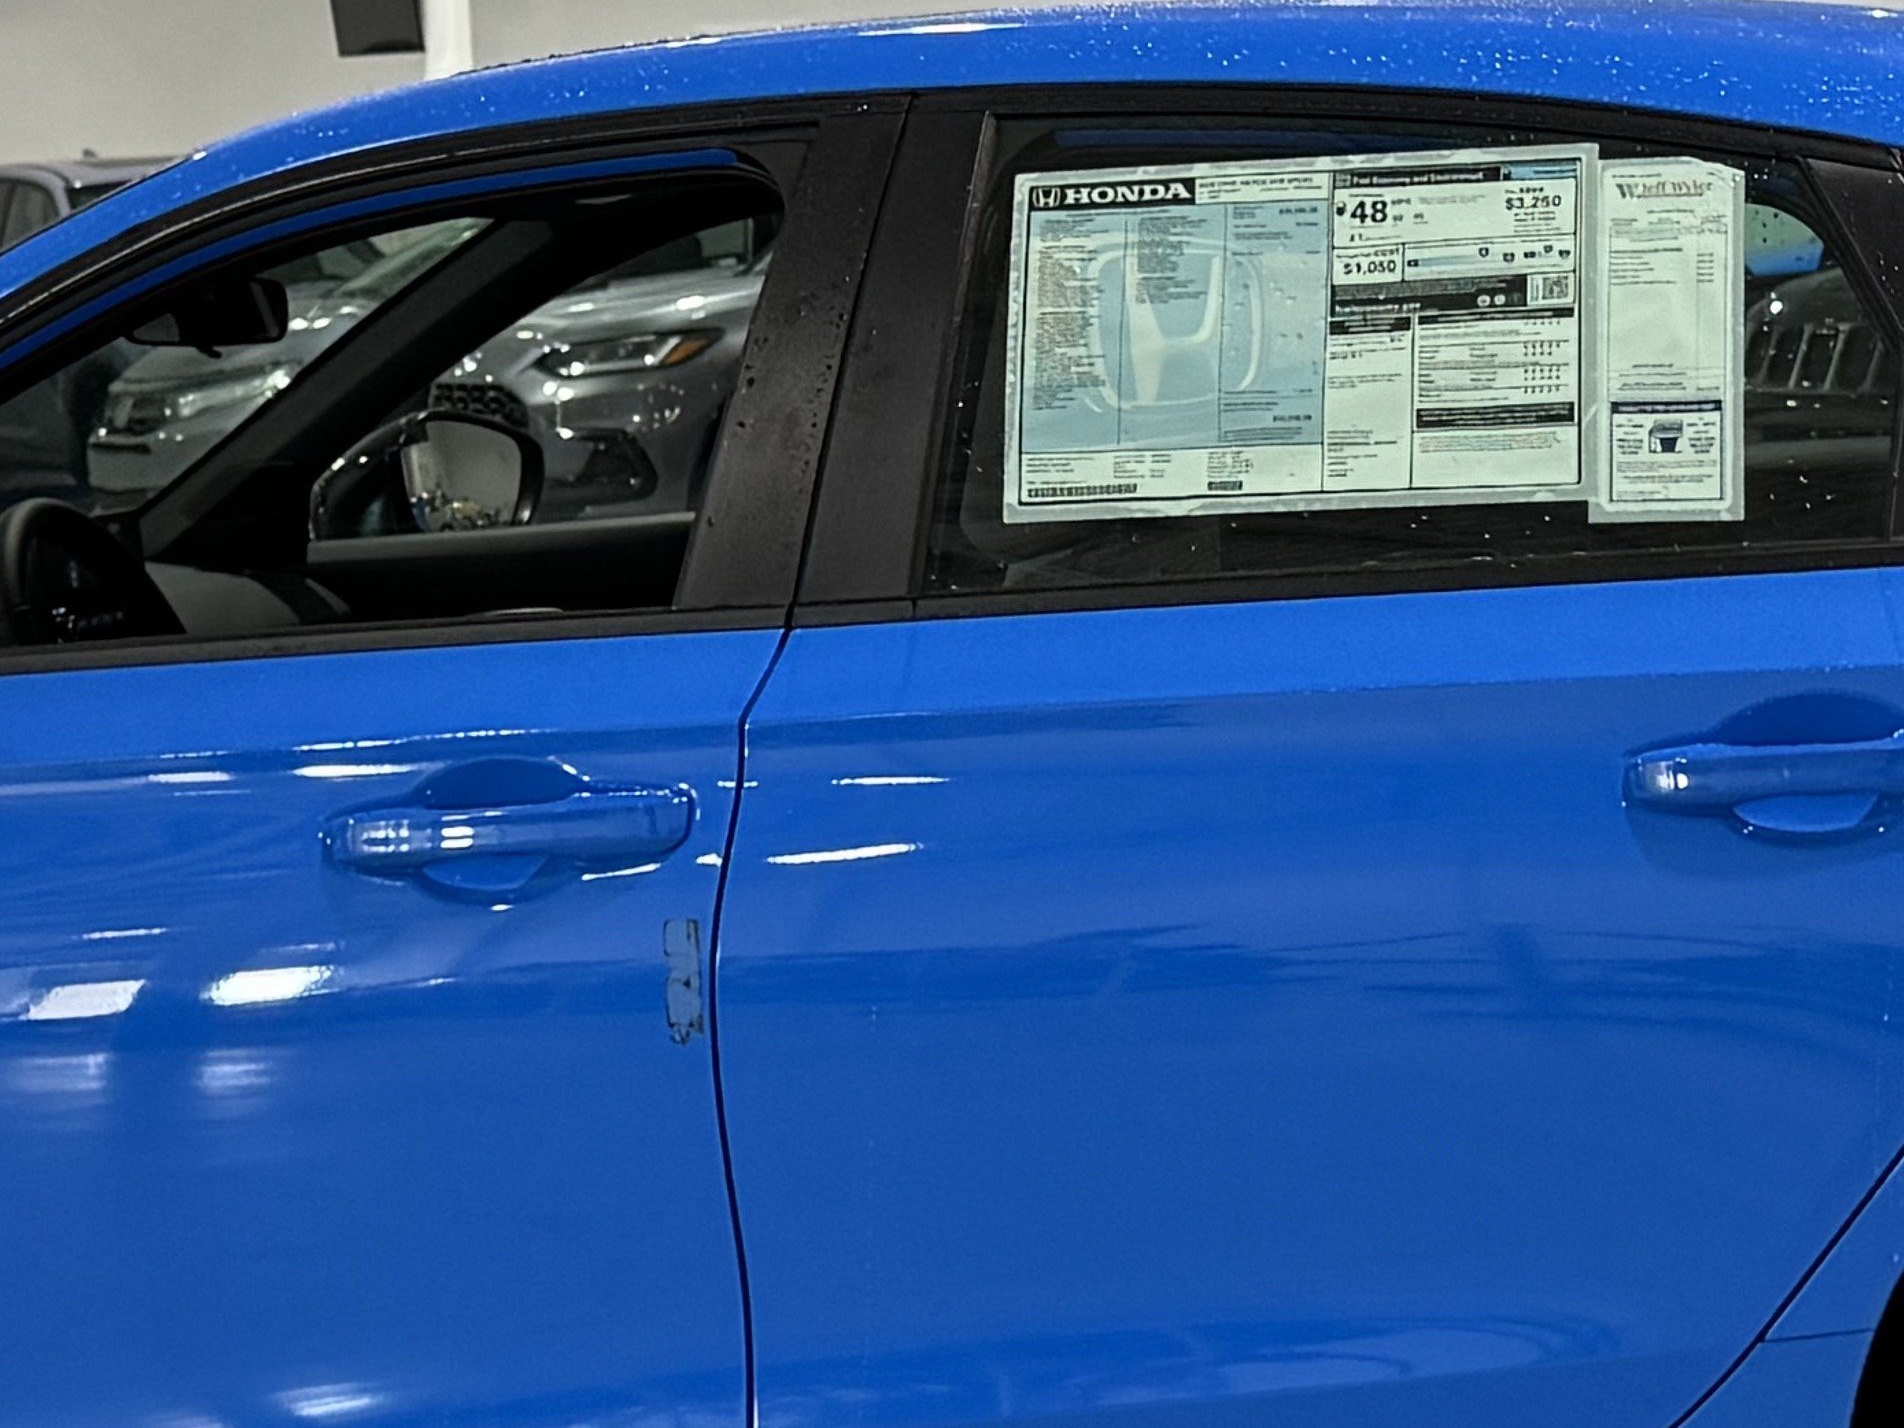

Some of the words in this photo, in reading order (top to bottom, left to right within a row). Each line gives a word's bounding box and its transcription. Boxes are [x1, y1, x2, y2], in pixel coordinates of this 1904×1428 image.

[1063, 182, 1192, 205] HONDA
[1349, 199, 1388, 224] 48
[1343, 259, 1397, 275] $1,050
